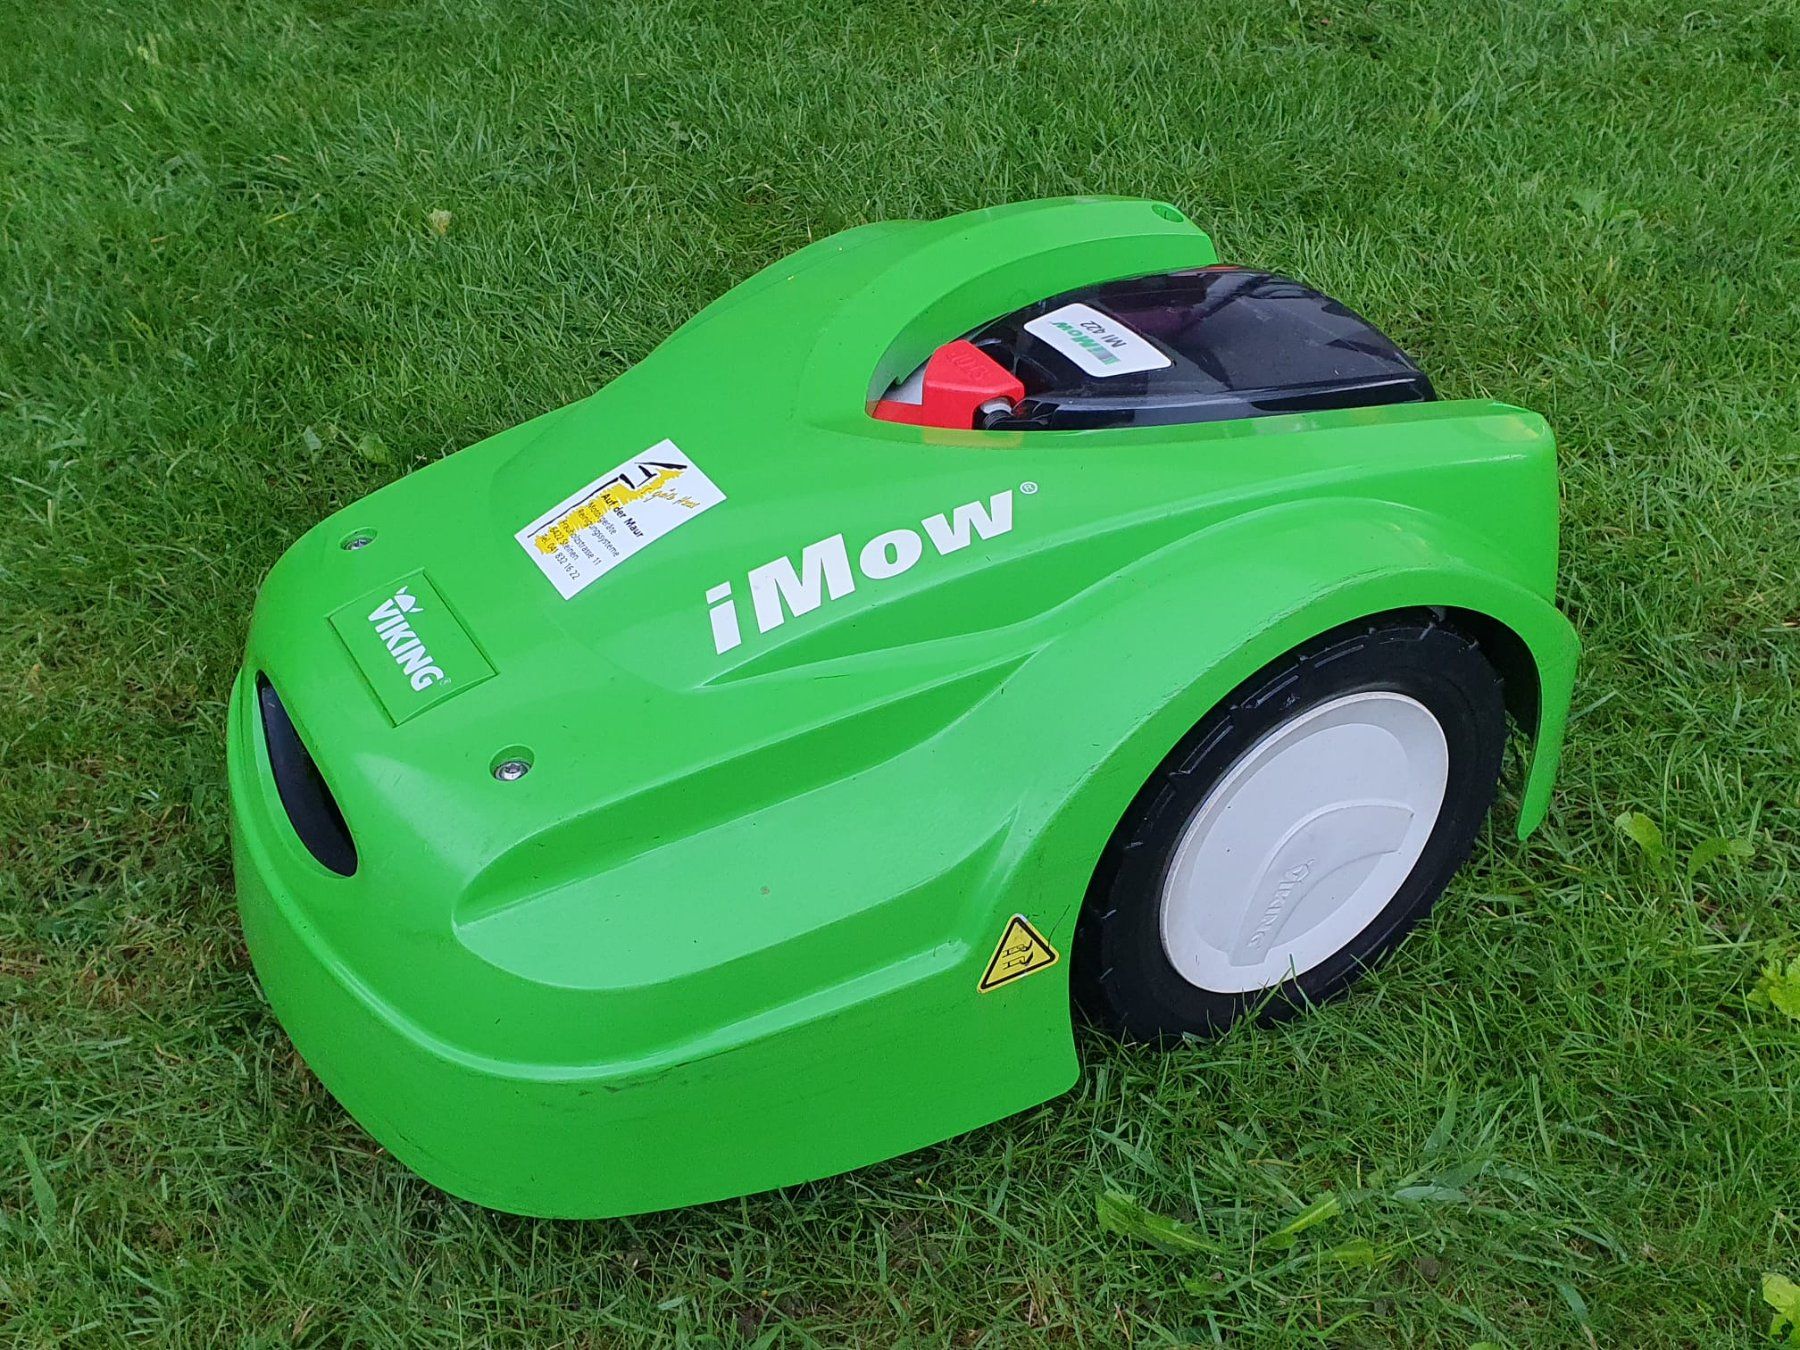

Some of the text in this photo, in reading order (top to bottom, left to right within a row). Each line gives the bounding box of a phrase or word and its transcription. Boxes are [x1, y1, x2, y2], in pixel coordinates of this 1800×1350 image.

[1080, 321, 1127, 348] MI 422
[578, 508, 620, 557] Reinigungssysteme
[601, 493, 644, 538] Auf der Maur
[549, 527, 580, 561] 6422 Steinen
[555, 552, 568, 564] 832
[564, 562, 574, 573] 16
[569, 570, 581, 580] 22
[592, 557, 602, 566] 11
[706, 490, 1012, 655] iMow
[367, 598, 445, 692] VIKING
[1246, 860, 1313, 950] VIKING
